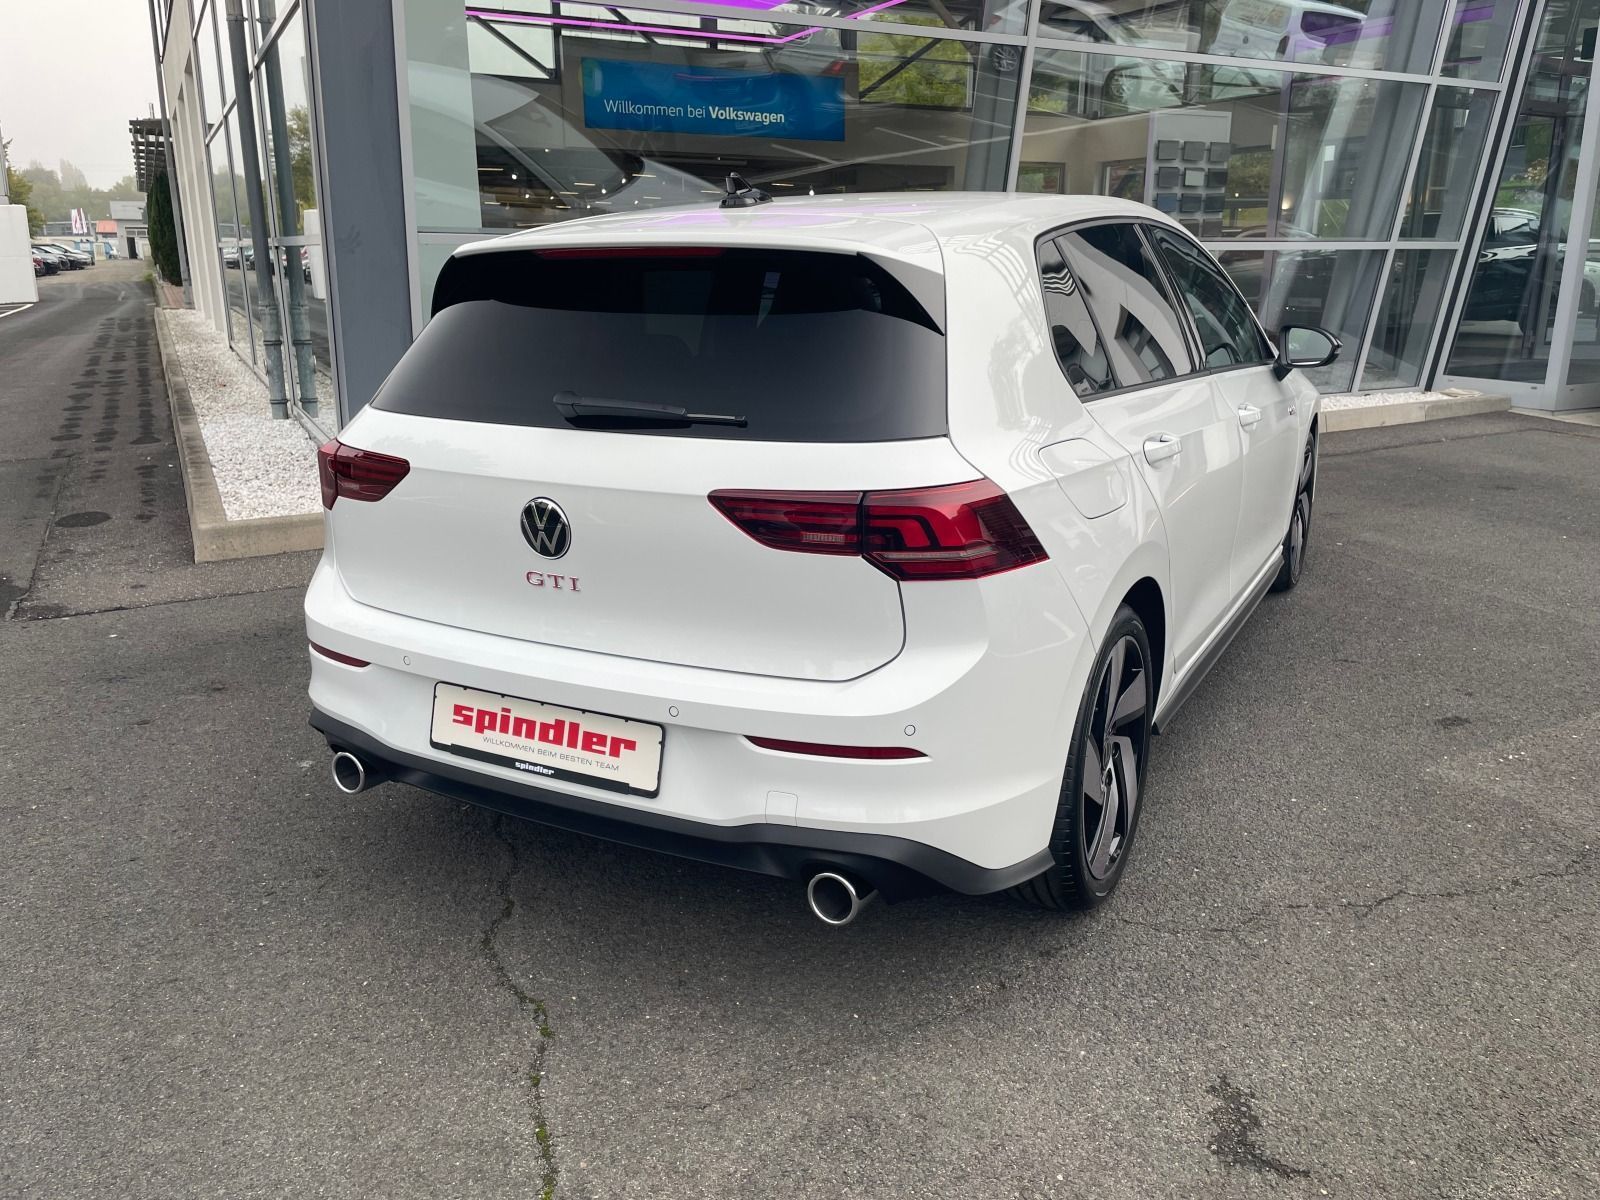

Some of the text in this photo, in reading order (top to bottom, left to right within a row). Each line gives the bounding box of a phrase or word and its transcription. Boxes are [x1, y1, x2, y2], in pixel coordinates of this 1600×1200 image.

[604, 99, 785, 125] Willkommen bei Volkswagen
[526, 570, 581, 592] GTI
[452, 703, 637, 759] spindler
[482, 736, 620, 772] WILLKOMMEN BEIM BESTEN TEAM
[514, 761, 555, 775] spindler
